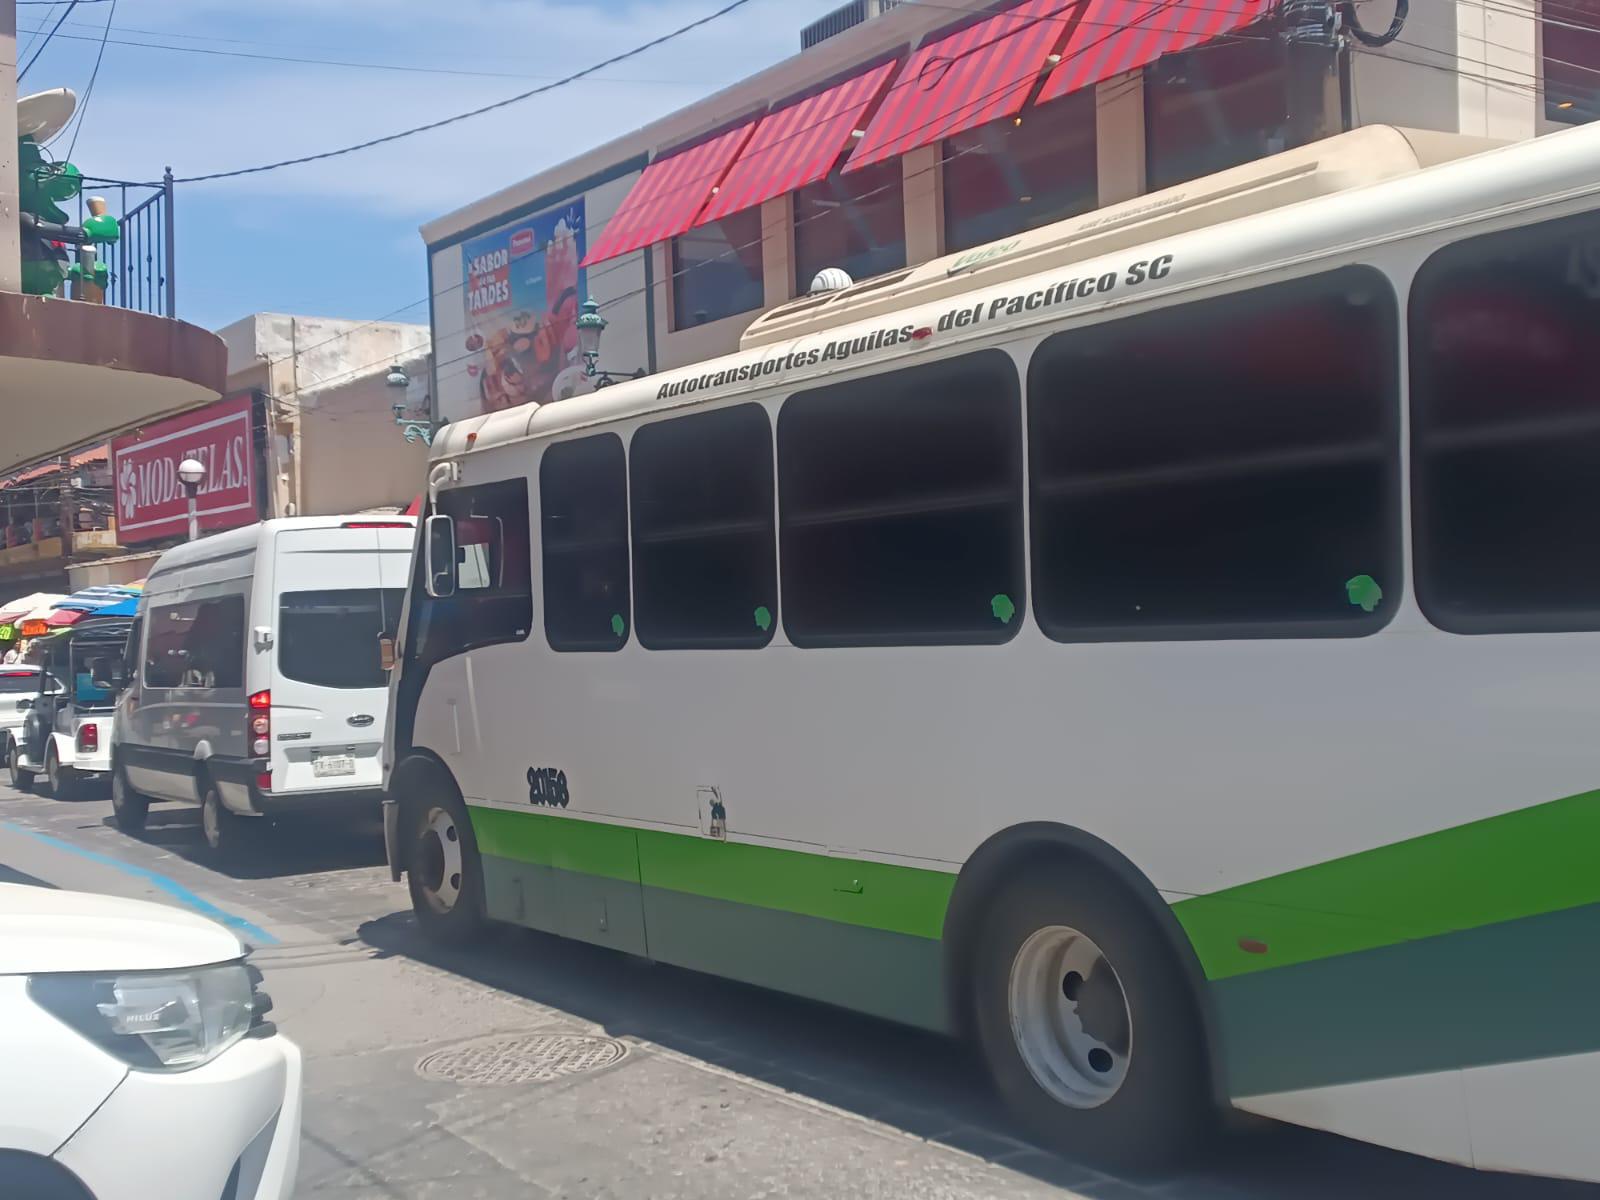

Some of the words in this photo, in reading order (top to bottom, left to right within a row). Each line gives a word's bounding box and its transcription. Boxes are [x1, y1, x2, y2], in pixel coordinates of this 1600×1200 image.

[468, 280, 509, 311] TARDES
[656, 347, 820, 400] Autotransportes
[821, 324, 914, 363] Aguilas
[937, 303, 984, 332] del
[988, 271, 1118, 320] Pacífico
[1125, 254, 1174, 286] SC
